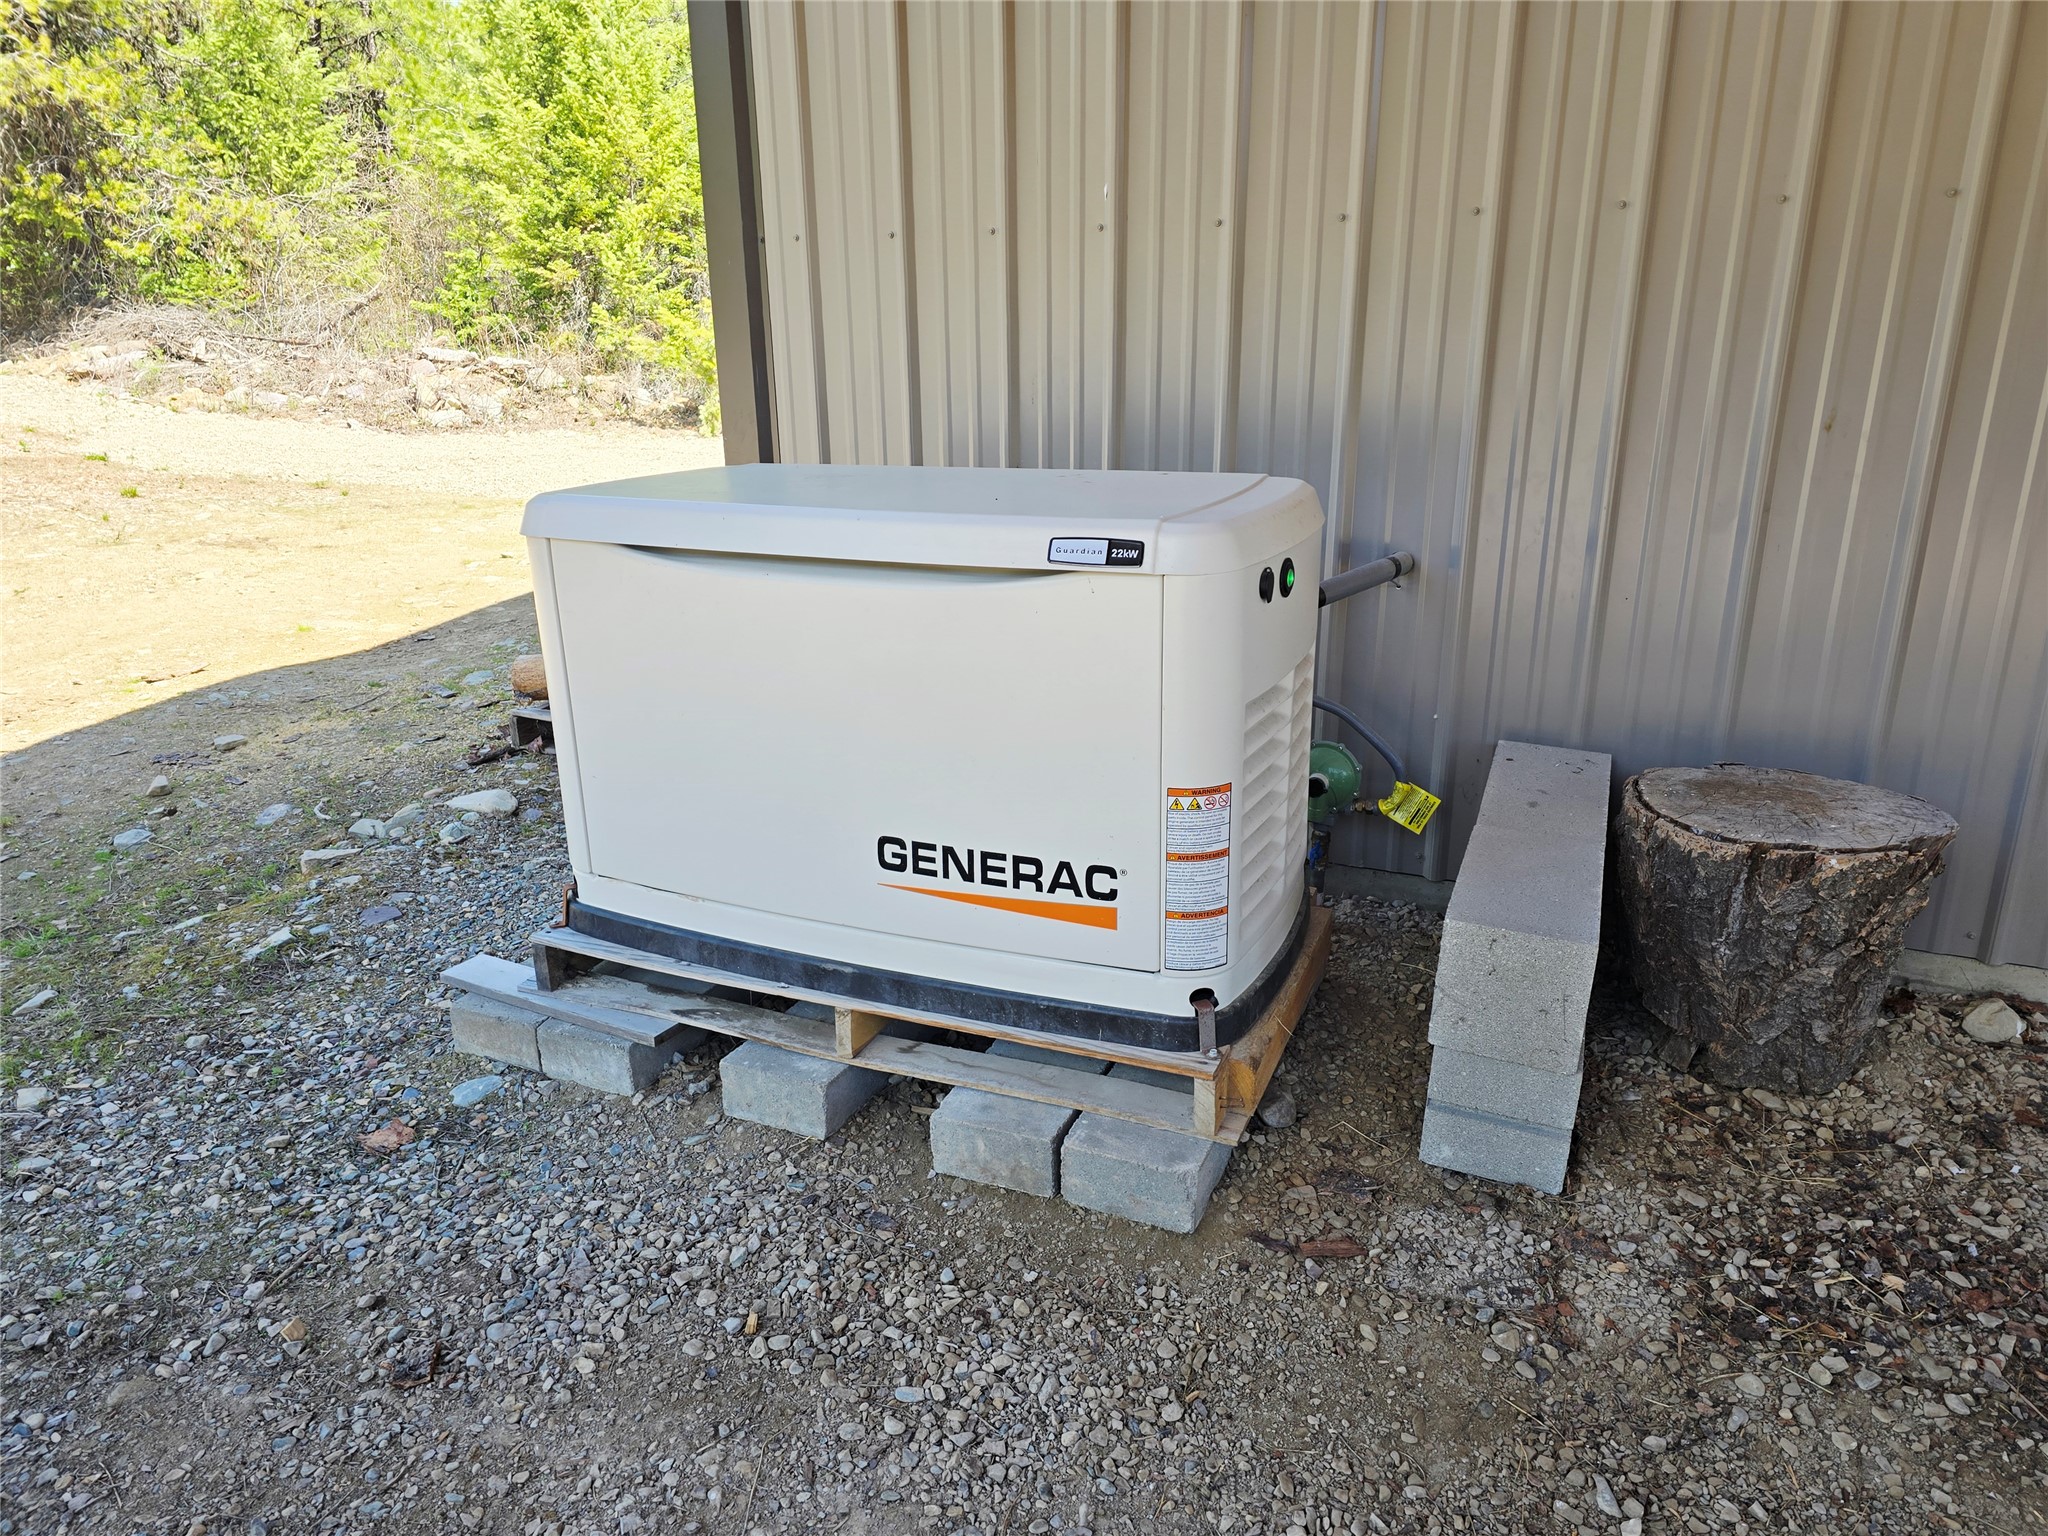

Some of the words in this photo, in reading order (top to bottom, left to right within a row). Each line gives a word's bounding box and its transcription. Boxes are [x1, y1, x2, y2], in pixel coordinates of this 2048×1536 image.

[1056, 547, 1103, 555] Guardian
[1111, 548, 1139, 558] 22kW
[1191, 788, 1221, 796] WARNING
[1177, 850, 1228, 861] AVERTISSEMENT
[877, 835, 1118, 902] GENERAC
[1181, 909, 1224, 919] ADVERTENCIA
